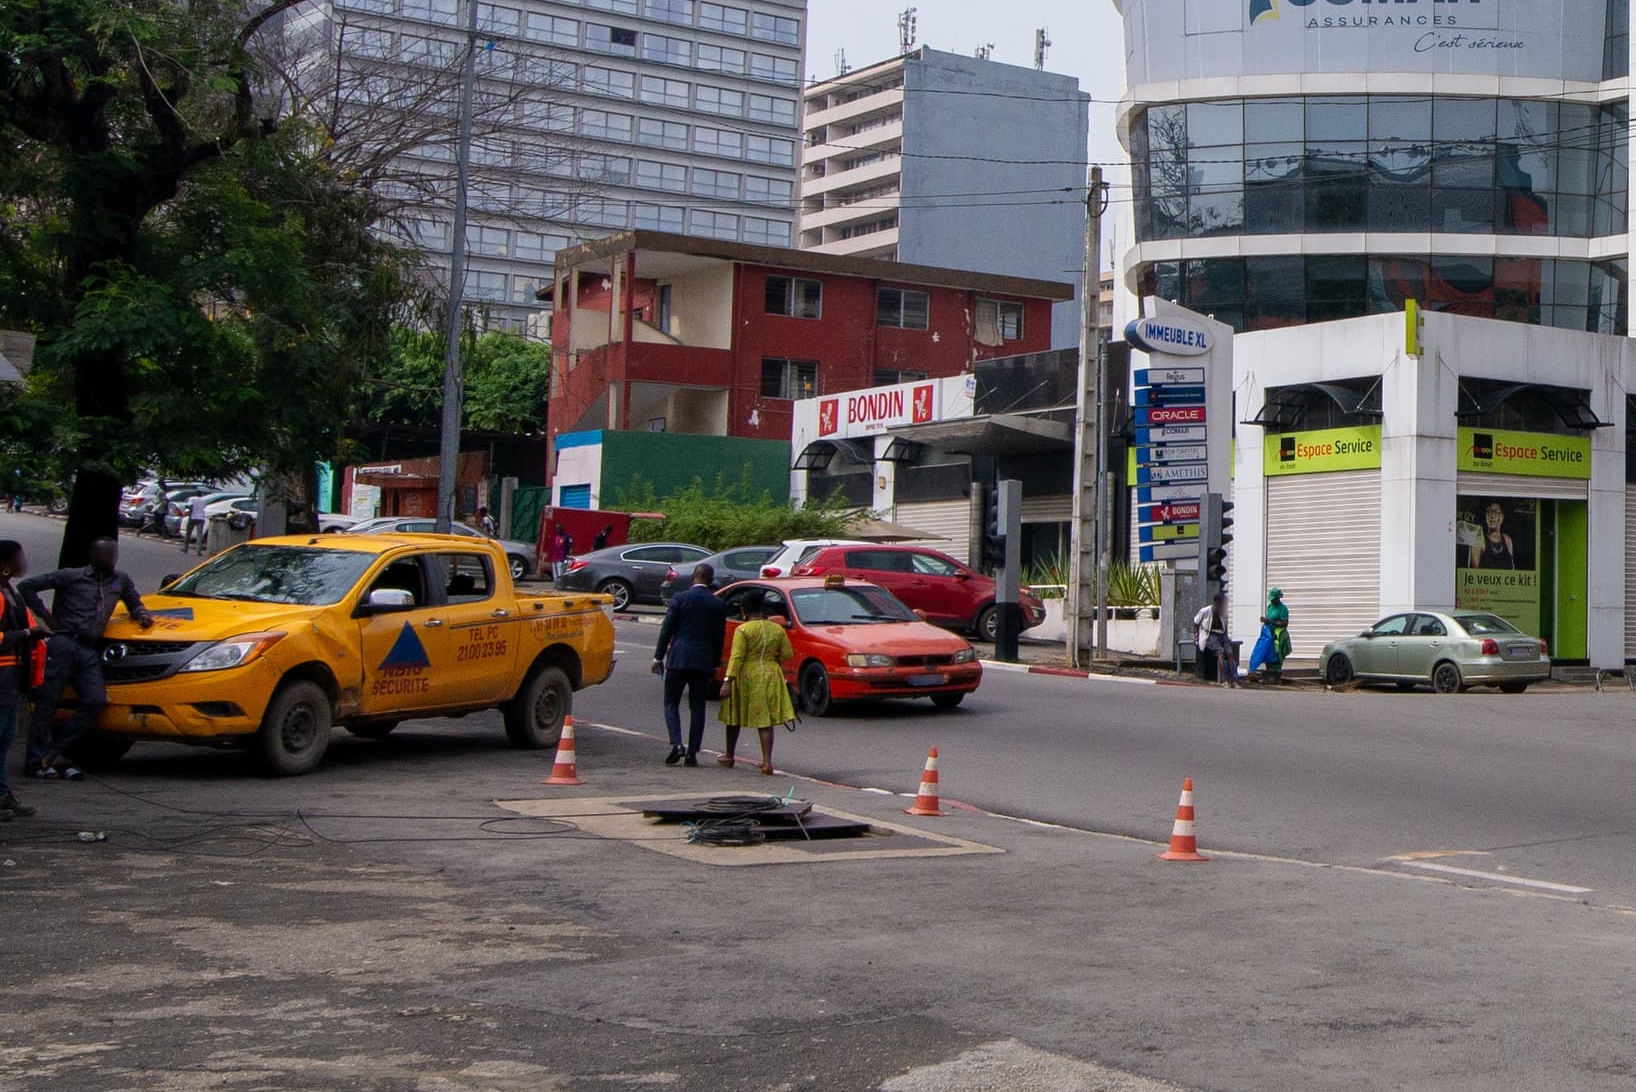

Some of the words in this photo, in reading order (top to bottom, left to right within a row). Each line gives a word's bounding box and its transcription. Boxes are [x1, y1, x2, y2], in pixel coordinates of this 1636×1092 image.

[1307, 15, 1457, 27] ASSURANCES
[1414, 32, 1462, 52] C'est
[1468, 34, 1525, 49] sérieux
[1145, 323, 1194, 346] IMMEUBLE
[1195, 333, 1207, 349] XL
[849, 390, 904, 424] BONDIN
[1151, 410, 1199, 421] ORACLE
[1297, 443, 1332, 460] Espace
[1334, 438, 1373, 455] Service
[1495, 443, 1537, 460] Espace
[1541, 446, 1583, 462] Service
[1165, 467, 1206, 479] AMETHIS
[1172, 505, 1198, 515] BONDIN
[1464, 572, 1474, 586] Je
[1477, 574, 1502, 586] veux
[1504, 576, 1516, 586] ce
[1519, 574, 1532, 586] kit
[469, 627, 484, 642] TEL
[487, 626, 498, 639] PC
[372, 677, 429, 695] SECURITE
